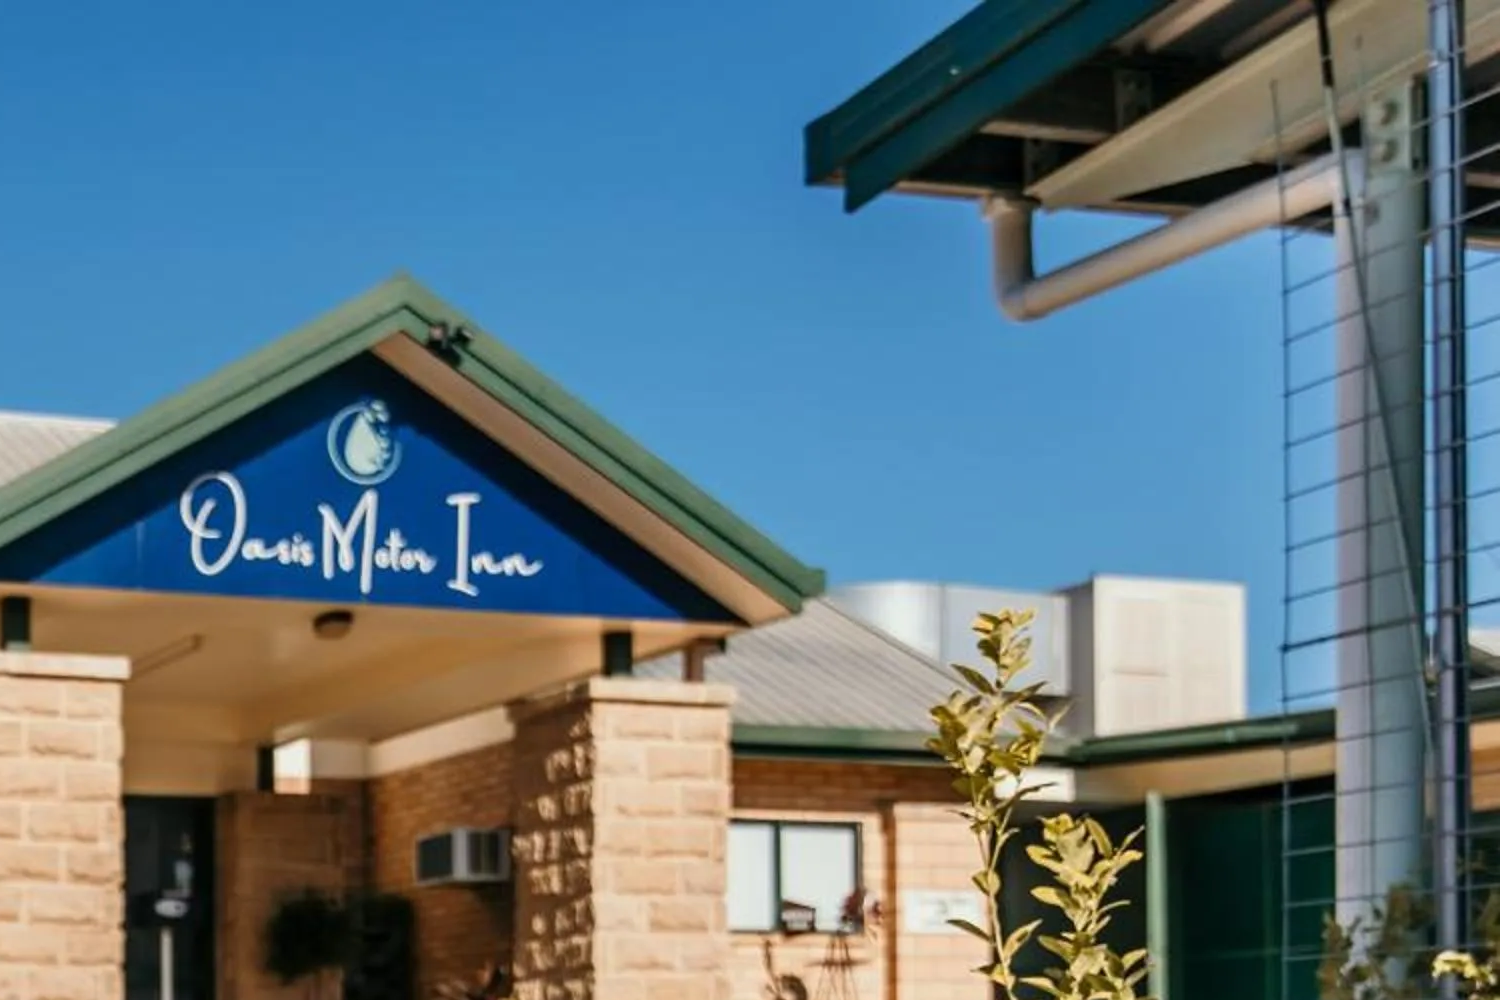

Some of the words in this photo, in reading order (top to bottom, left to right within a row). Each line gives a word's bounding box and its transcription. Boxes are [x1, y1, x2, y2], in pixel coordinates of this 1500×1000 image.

[180, 471, 315, 575] Oasis
[318, 489, 437, 594] Motor
[446, 493, 543, 596] Inn
